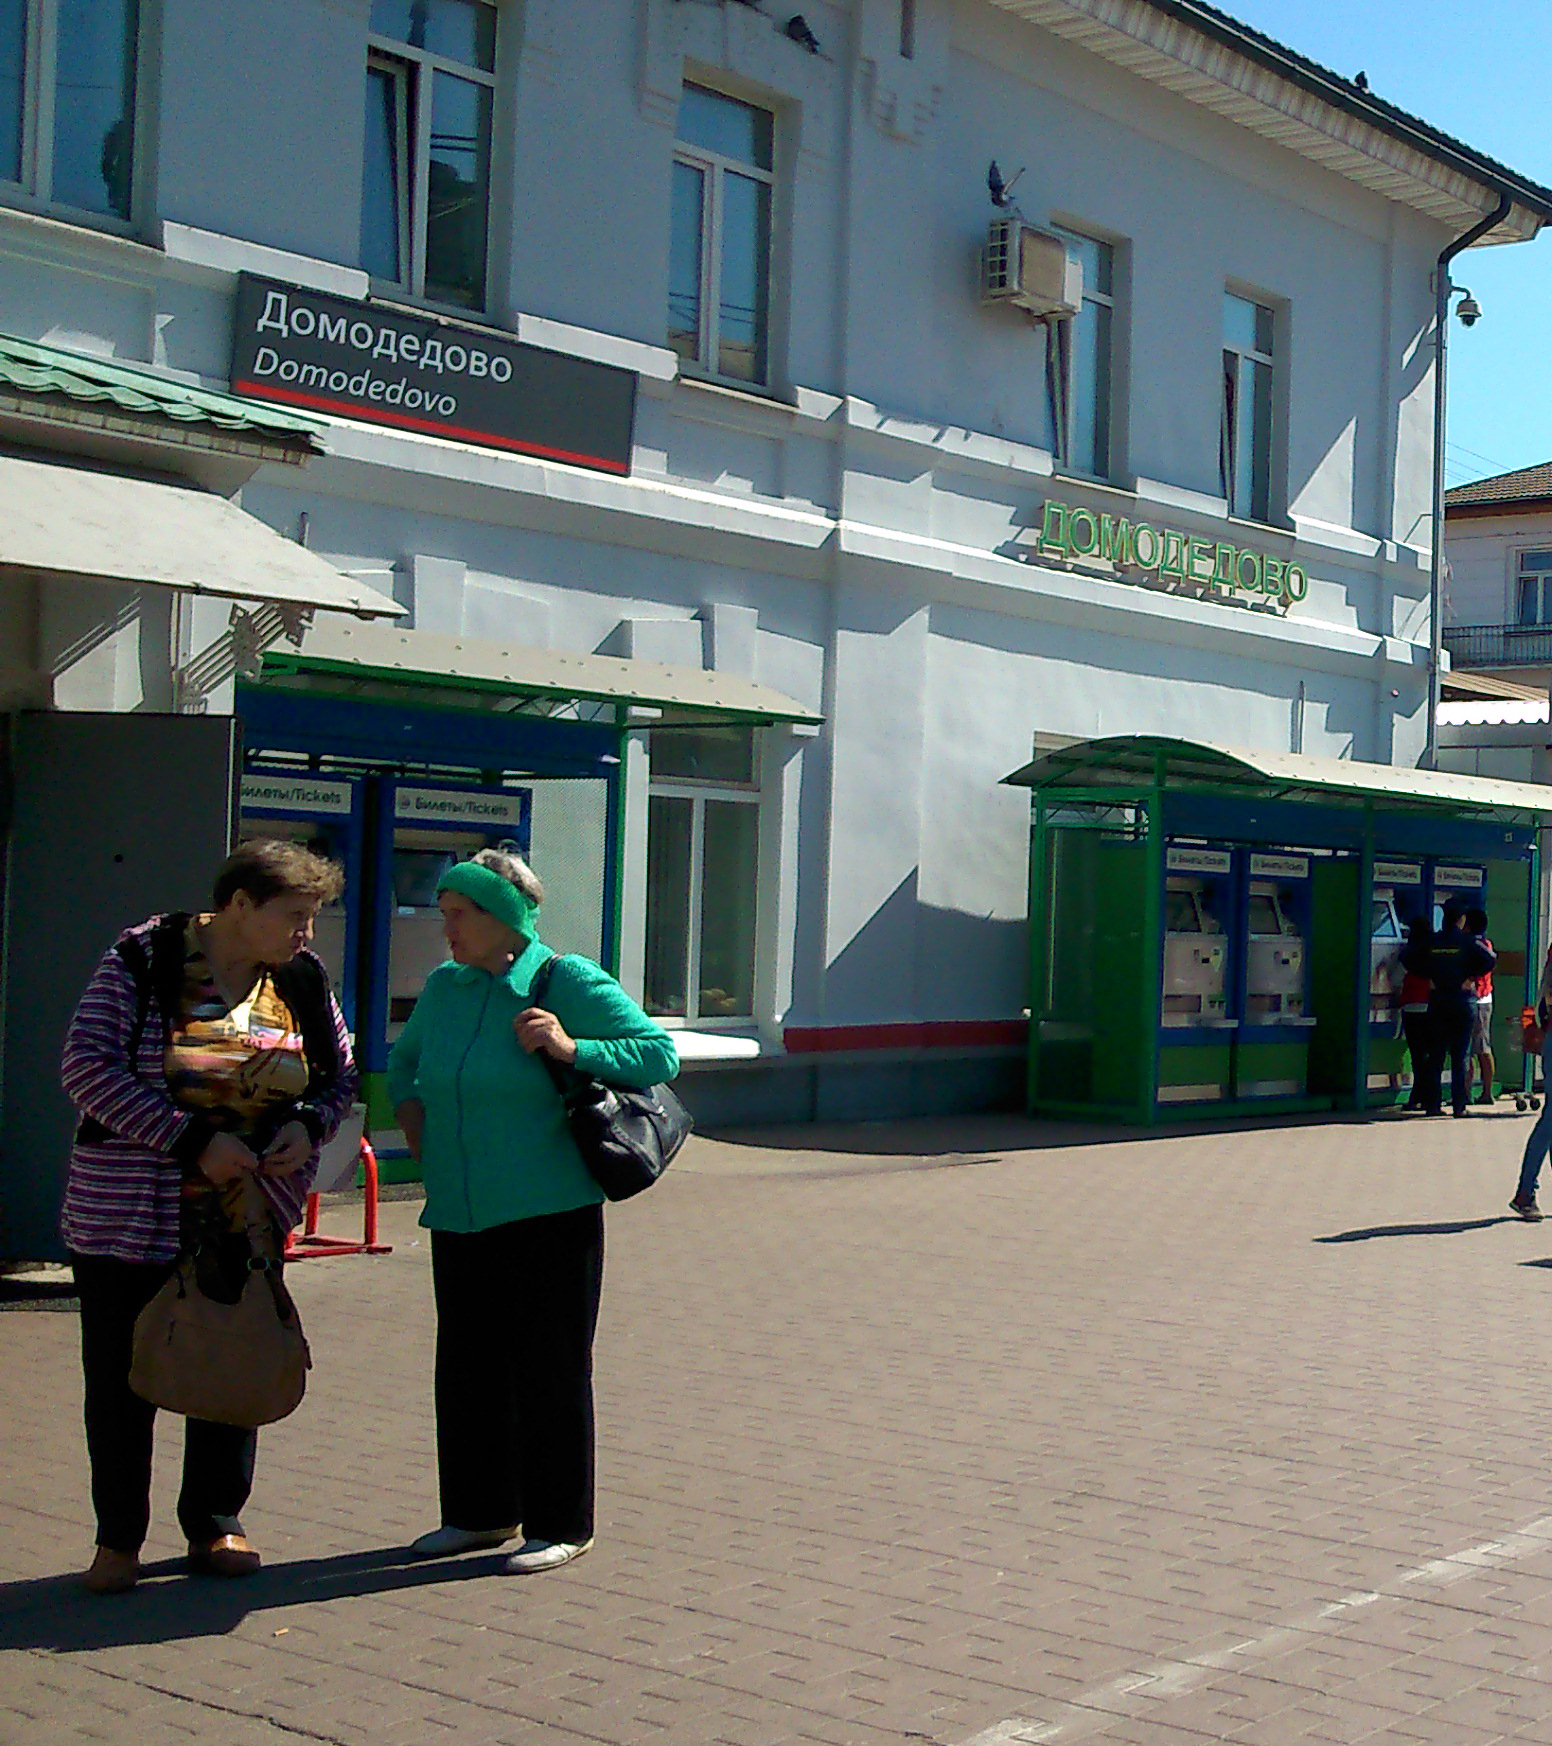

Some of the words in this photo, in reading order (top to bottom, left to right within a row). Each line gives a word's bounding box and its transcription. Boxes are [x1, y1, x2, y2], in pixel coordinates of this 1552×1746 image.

[253, 348, 457, 416] Domodedovo
[257, 291, 512, 383] Домодедово
[1037, 499, 1308, 601] ДОМОДЕДОВО
